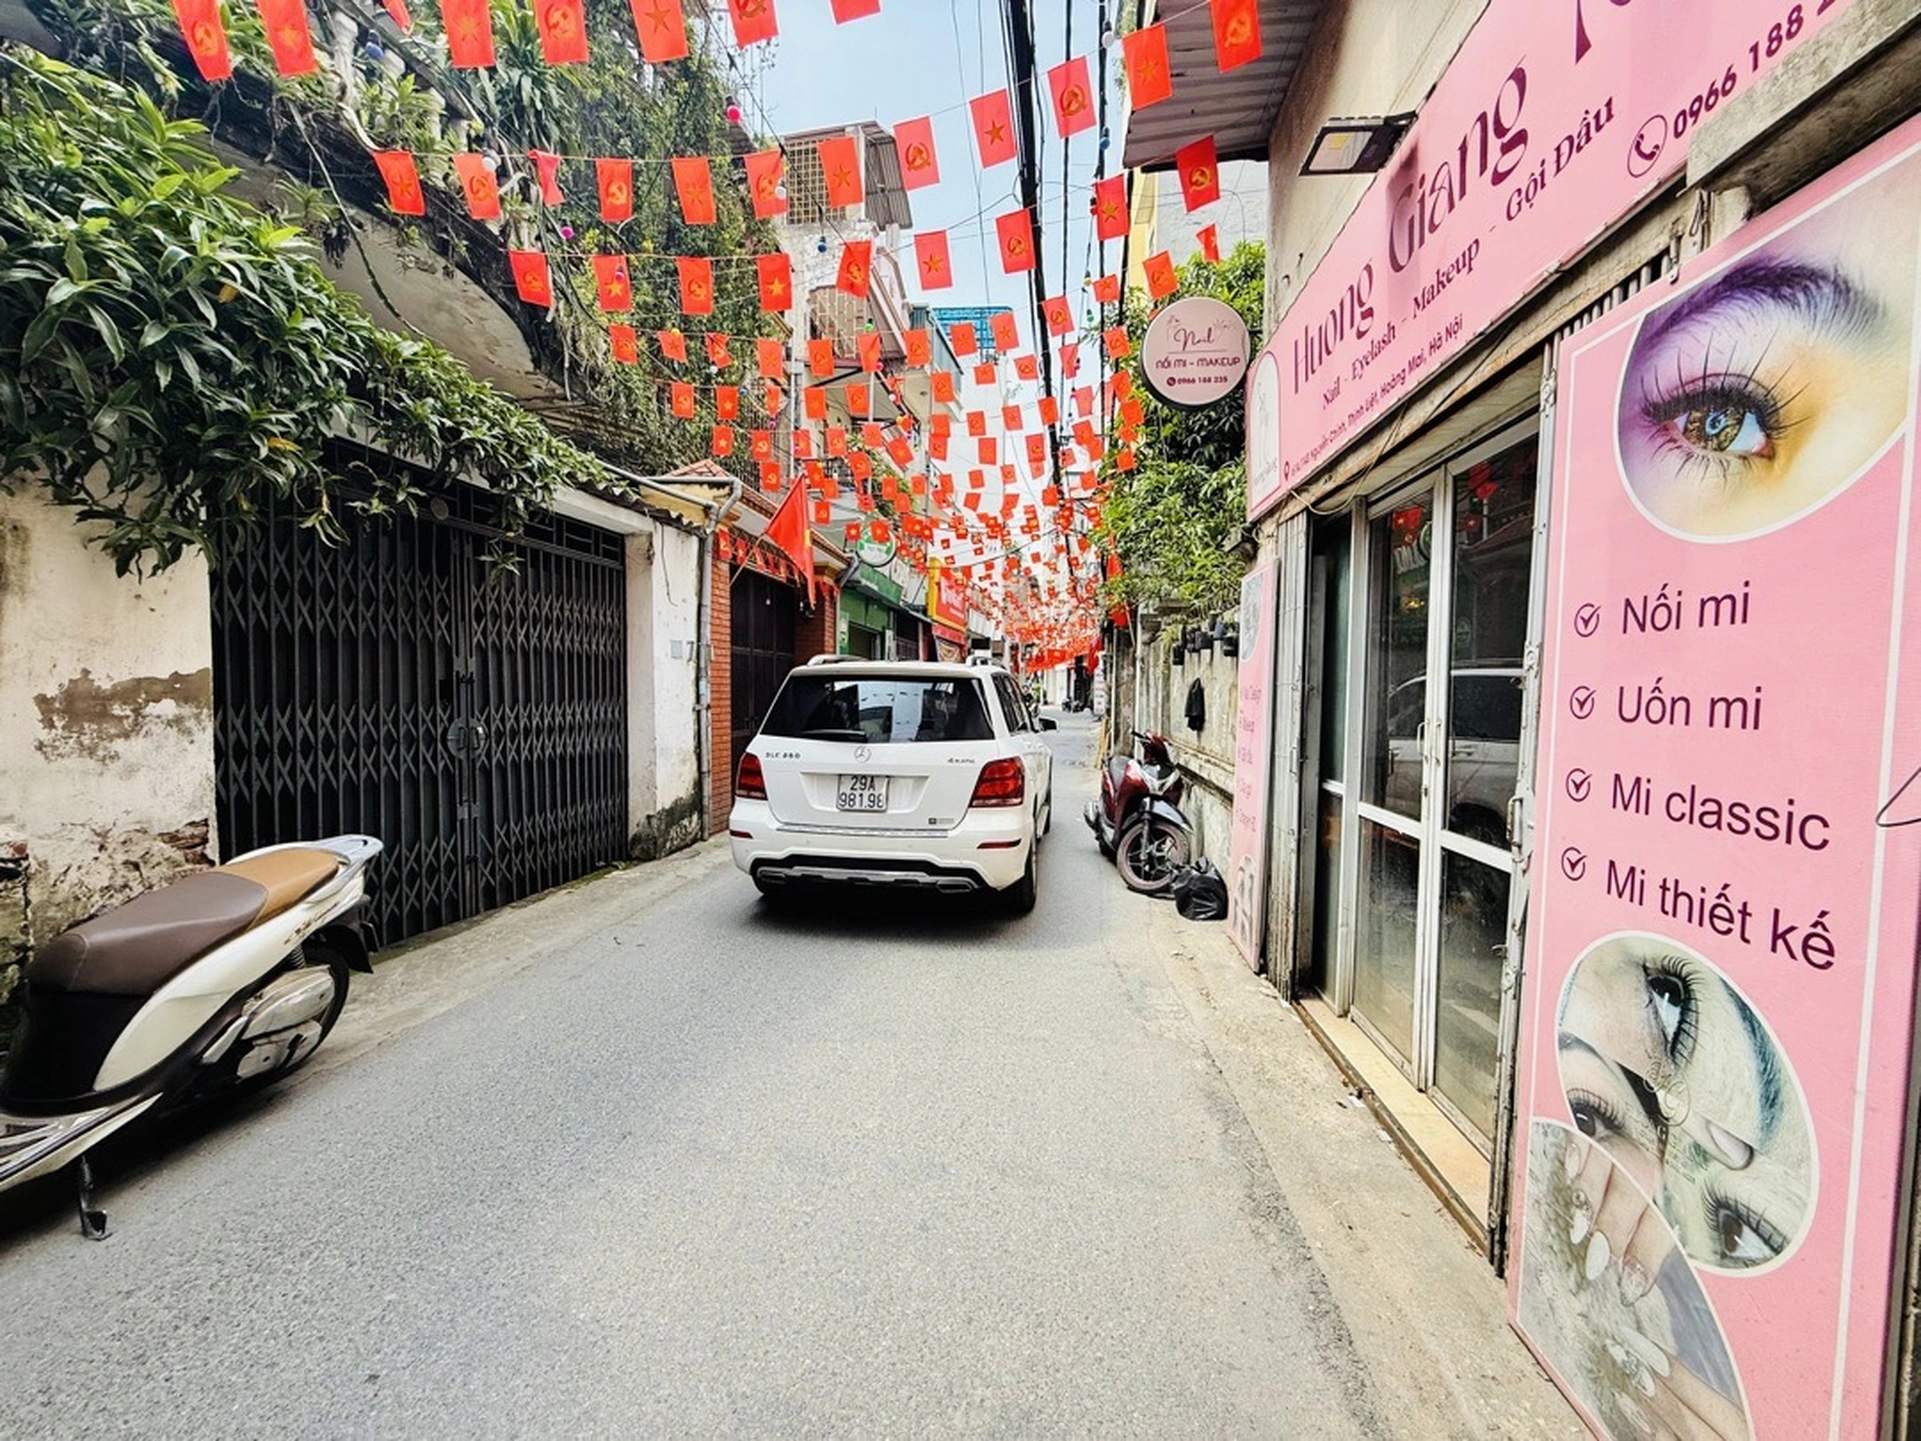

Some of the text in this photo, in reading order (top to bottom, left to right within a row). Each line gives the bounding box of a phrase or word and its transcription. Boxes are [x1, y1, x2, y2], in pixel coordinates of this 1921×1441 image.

[1673, 3, 1803, 139] 0966 188
[1389, 55, 1528, 273] Giang
[1322, 376, 1340, 410] Nail
[1352, 321, 1396, 381] Eyelash
[1412, 238, 1480, 319] Makeup
[1506, 158, 1546, 221] Gội
[1554, 96, 1614, 177] Đầu
[1197, 357, 1241, 368] MAKEUP
[1429, 332, 1443, 356] Hà
[1445, 313, 1463, 340] Nội
[1622, 580, 1750, 635] Nối mi
[1618, 677, 1762, 731] Uốn mi
[850, 776, 875, 791] 29A
[1611, 773, 1830, 851] Mi classic
[1606, 859, 1836, 971] Mi thiết kế
